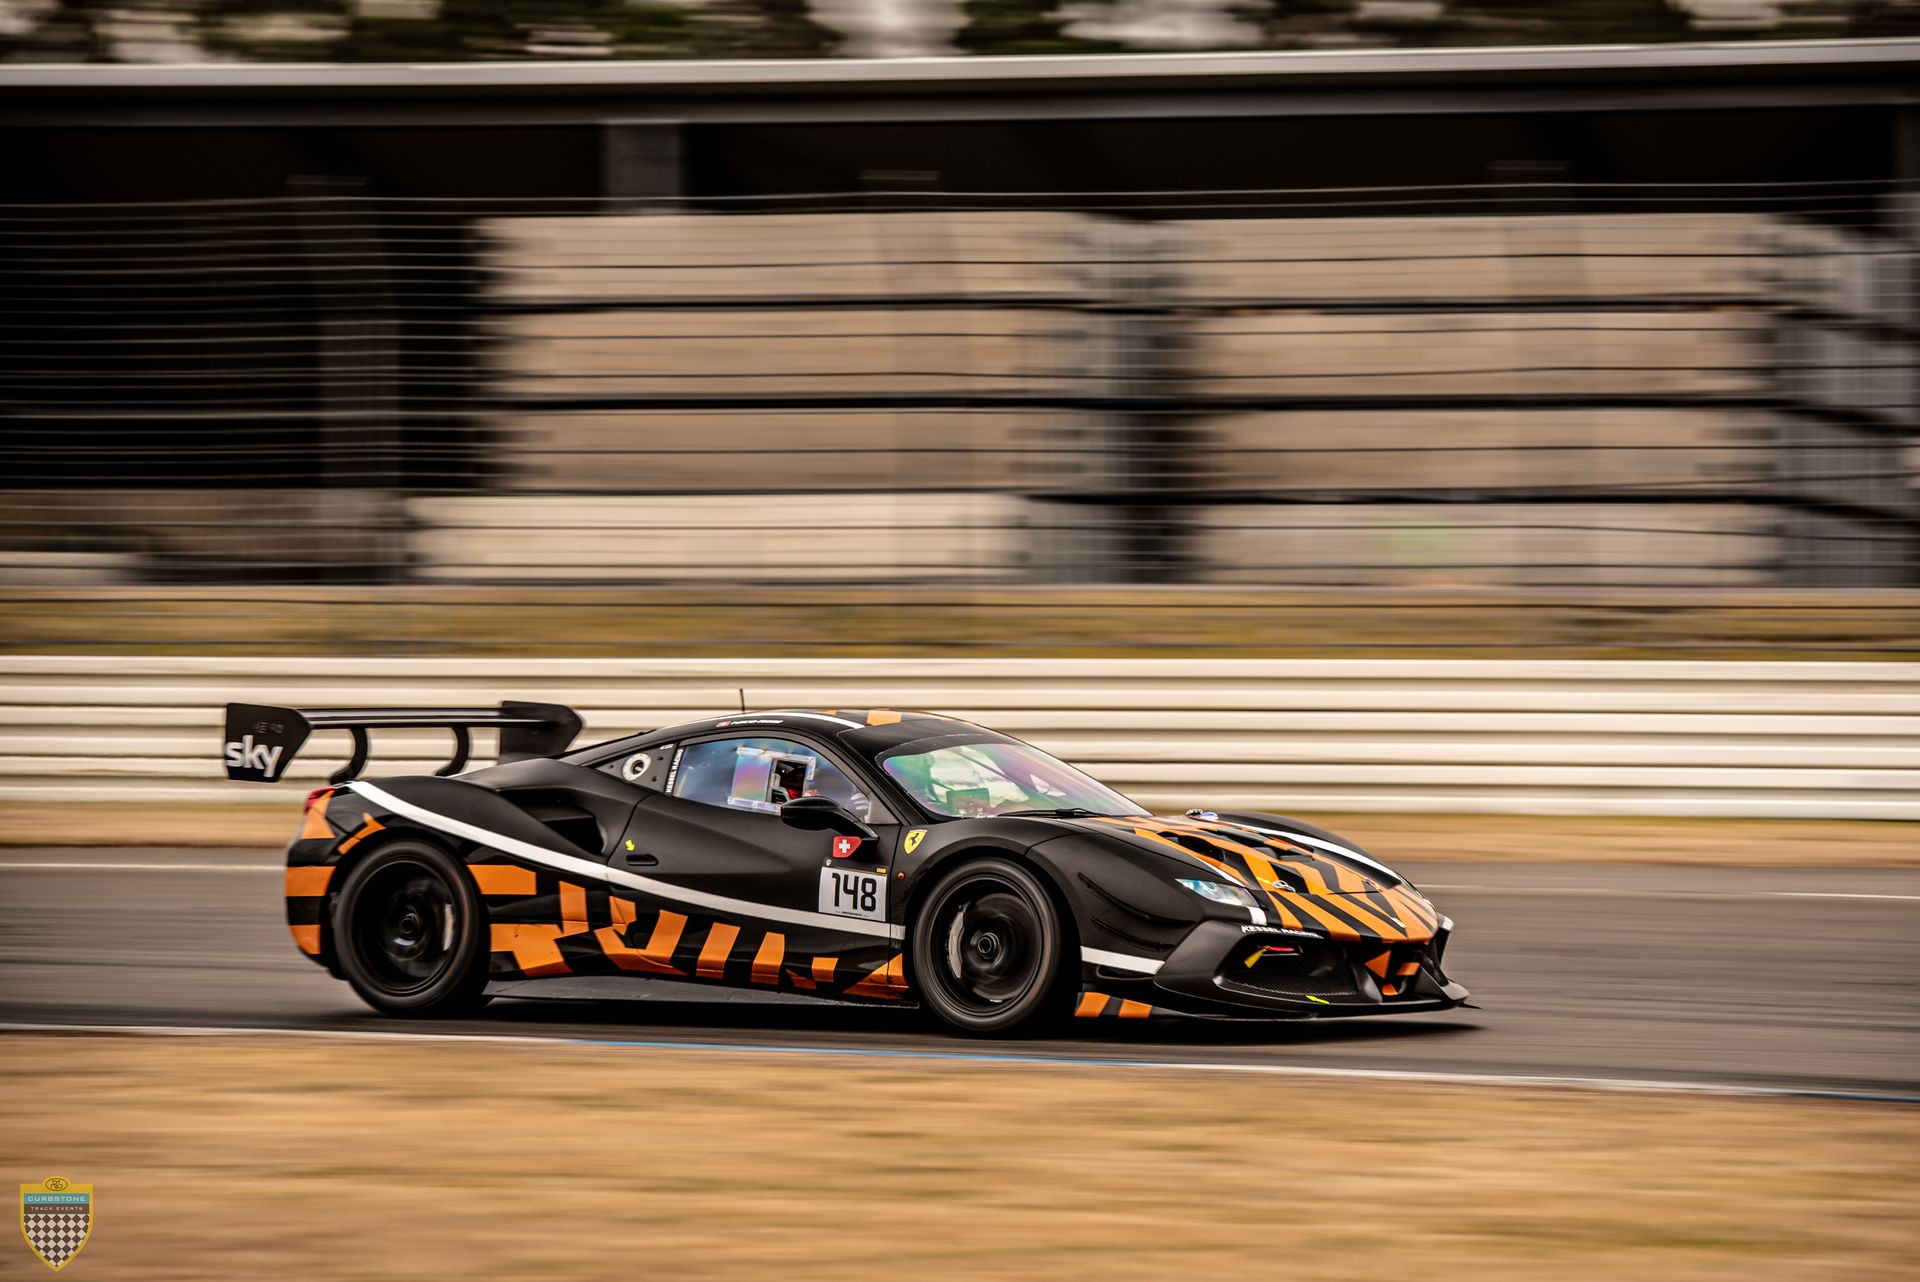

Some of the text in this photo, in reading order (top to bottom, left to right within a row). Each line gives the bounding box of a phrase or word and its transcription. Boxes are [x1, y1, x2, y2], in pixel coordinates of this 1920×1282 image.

[224, 735, 284, 777] sky
[832, 872, 877, 912] 148
[1241, 925, 1280, 934] KESSEL
